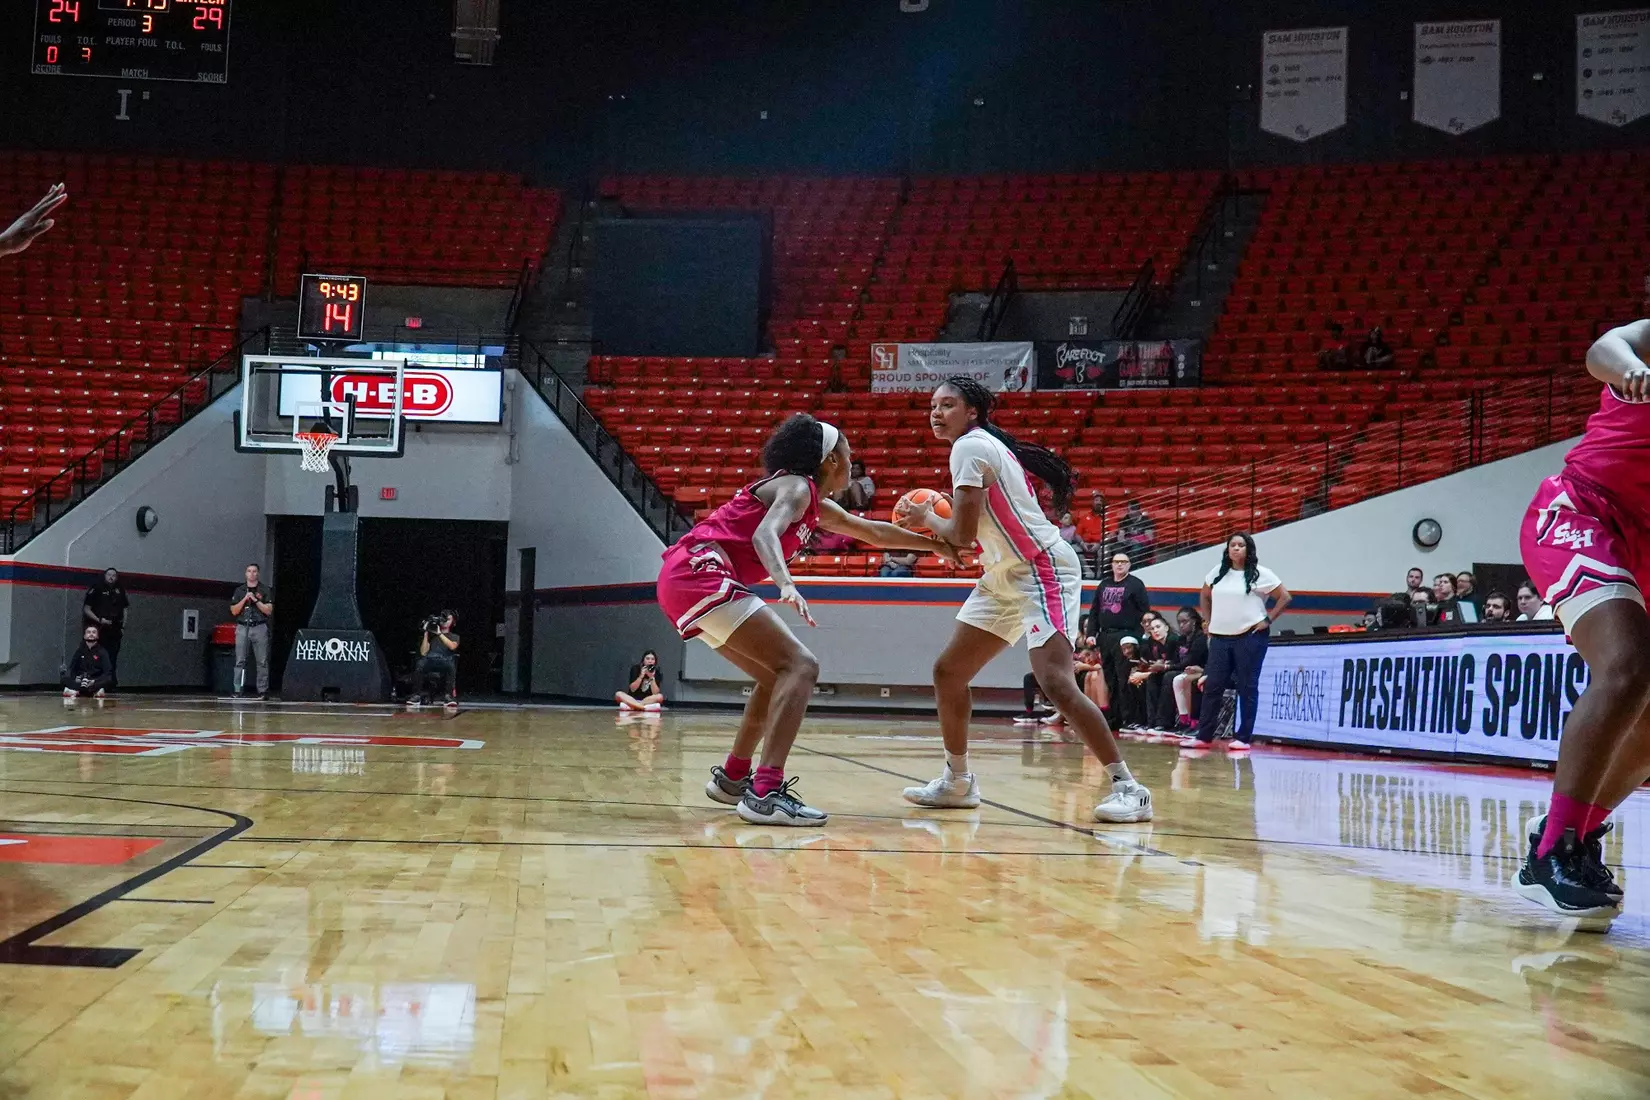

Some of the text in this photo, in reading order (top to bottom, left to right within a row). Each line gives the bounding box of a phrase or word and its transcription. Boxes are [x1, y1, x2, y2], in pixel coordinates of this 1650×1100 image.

[49, 0, 79, 22] 24
[192, 7, 222, 29] 29
[107, 18, 136, 27] PERIOD
[142, 15, 152, 32] 3
[1446, 23, 1494, 34] HOUSTON
[40, 35, 62, 43] FOULS
[106, 36, 158, 47] PLAYER FOUL
[201, 42, 222, 51] FOULS
[47, 46, 58, 63] 0
[36, 64, 61, 73] SCORE
[121, 68, 149, 78] MATCH
[198, 72, 224, 82] SCORE
[319, 282, 359, 301] 9:43
[324, 303, 350, 332] 14
[872, 374, 911, 382] PROUD
[974, 372, 990, 382] OF
[297, 638, 369, 655] MEMORIAL
[296, 650, 369, 662] HERMANN
[1273, 667, 1326, 699] MEMORIAL
[1338, 652, 1590, 740] PRESENTING SPONS
[1270, 693, 1324, 722] HERMANN
